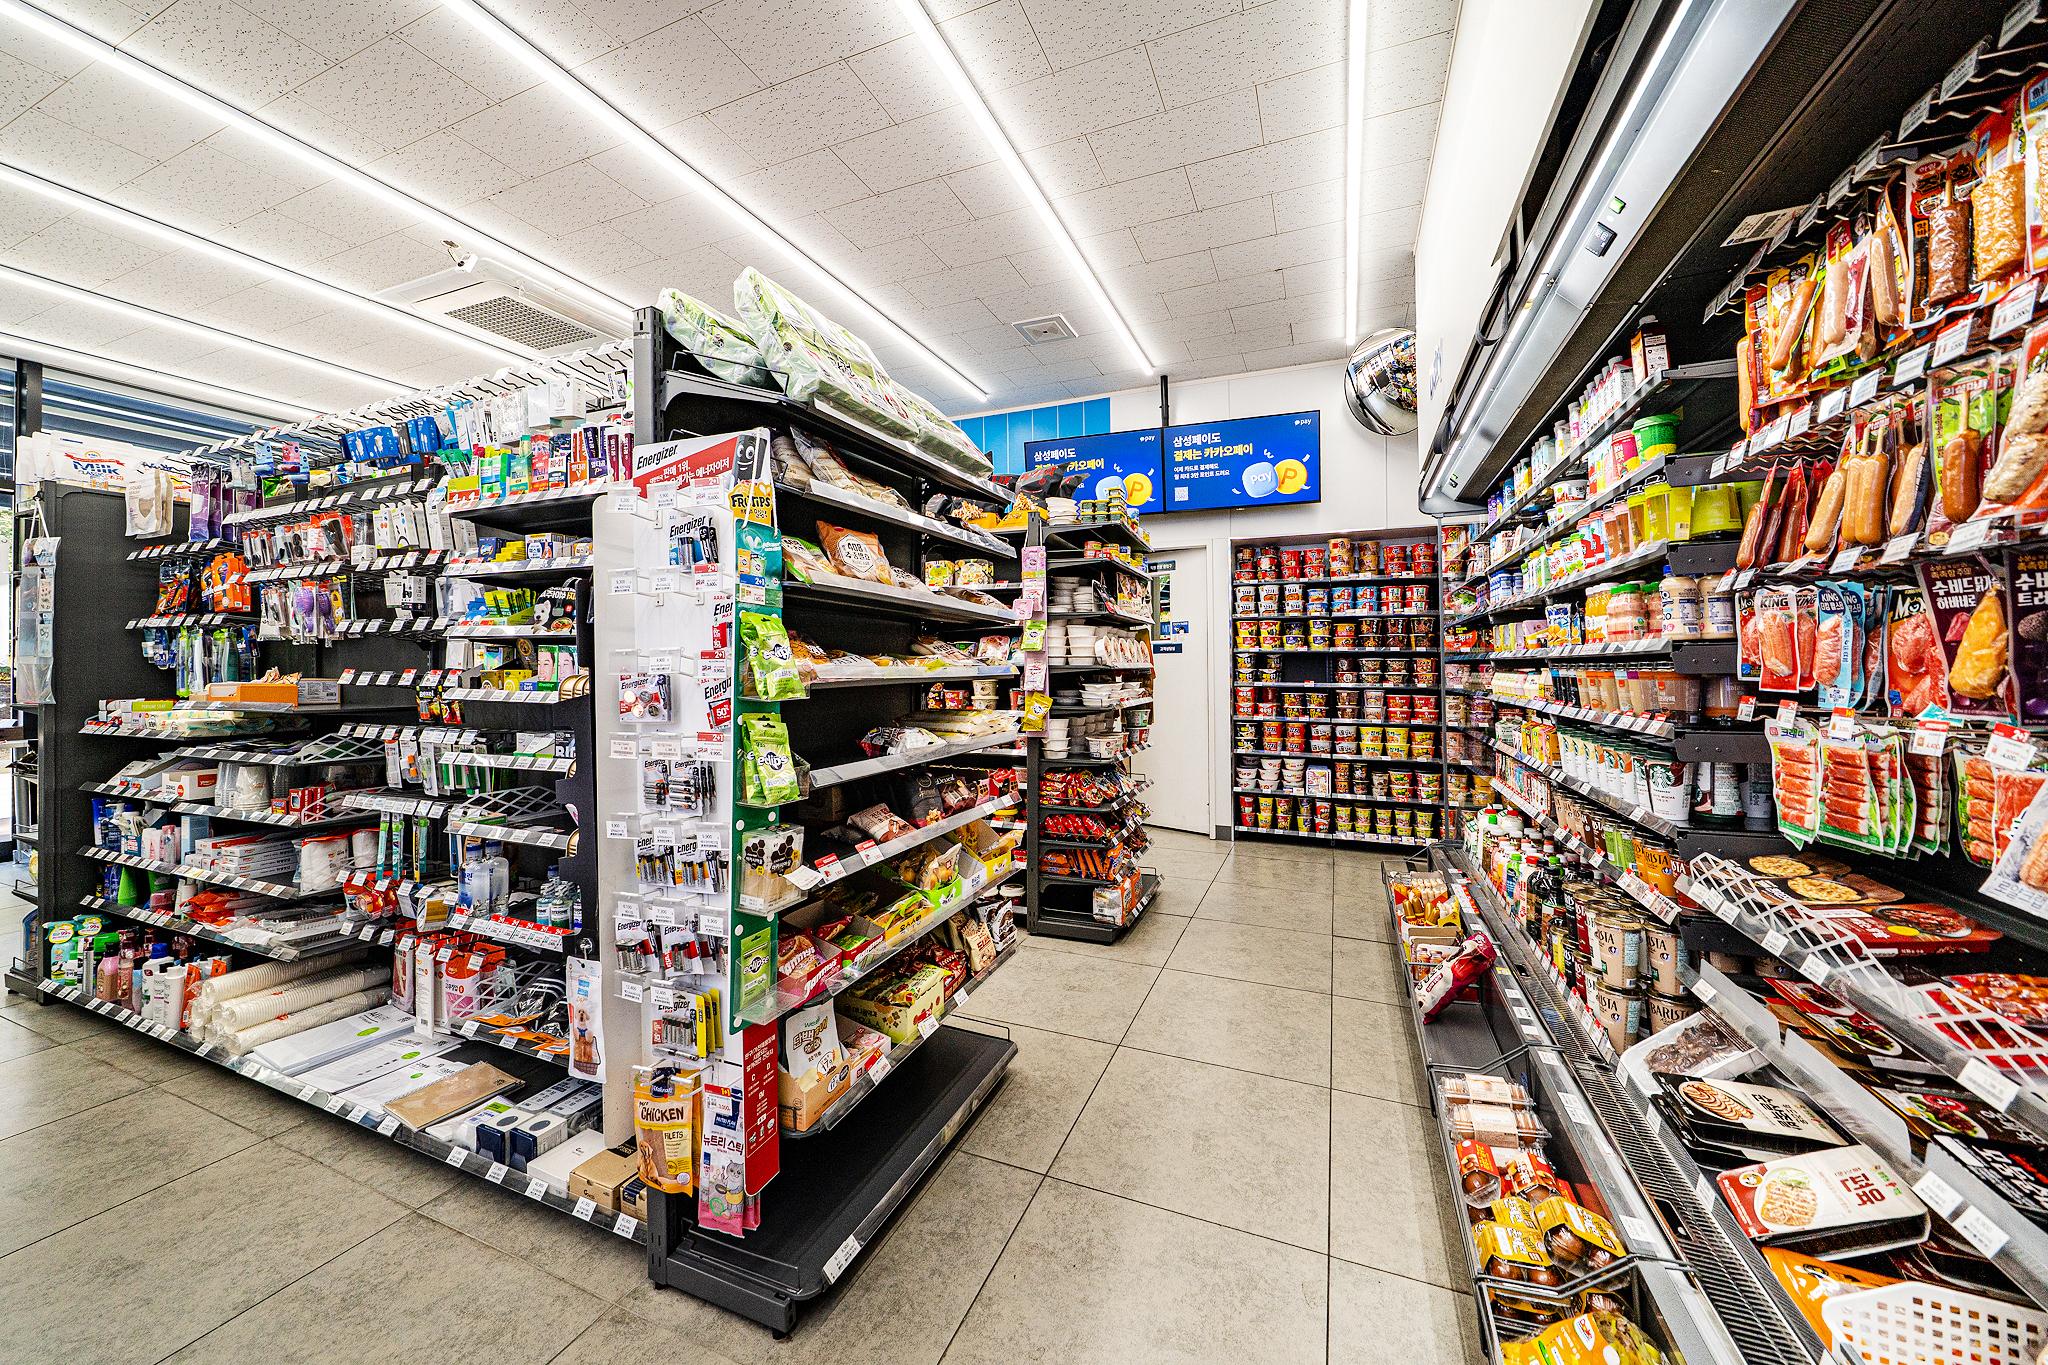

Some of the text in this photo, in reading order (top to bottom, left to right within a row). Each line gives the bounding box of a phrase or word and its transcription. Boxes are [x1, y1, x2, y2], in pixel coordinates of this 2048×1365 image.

[1173, 433, 1221, 448] 삼성페이도
[637, 444, 678, 470] Energizer
[1034, 448, 1076, 461] 삼성페이도
[1173, 443, 1253, 462] 결제는 카카오페이
[73, 461, 120, 475] Milk
[663, 465, 677, 480] 판매
[695, 457, 730, 477] 에너자이저
[1251, 471, 1273, 485] pay
[1281, 468, 1297, 485] P
[1130, 481, 1143, 497] P
[669, 516, 706, 538] Energizer
[755, 577, 766, 586] 2+1
[1932, 578, 1974, 596] 수비드
[1760, 598, 1789, 608] KING
[1821, 593, 1840, 603] KING
[1936, 595, 1977, 610] 하바네로
[714, 651, 726, 659] 2+1
[621, 678, 649, 690] Energizer
[713, 733, 724, 741] 2+1
[2011, 729, 2031, 744] 2+1
[617, 920, 641, 931] Energizer
[751, 1073, 756, 1082] C
[720, 1087, 731, 1097] 1+1
[640, 1107, 684, 1122] CHICKEN
[664, 1131, 684, 1140] FILETS
[703, 1133, 726, 1148] 뉴트리
[1579, 1318, 1593, 1339] Dole
